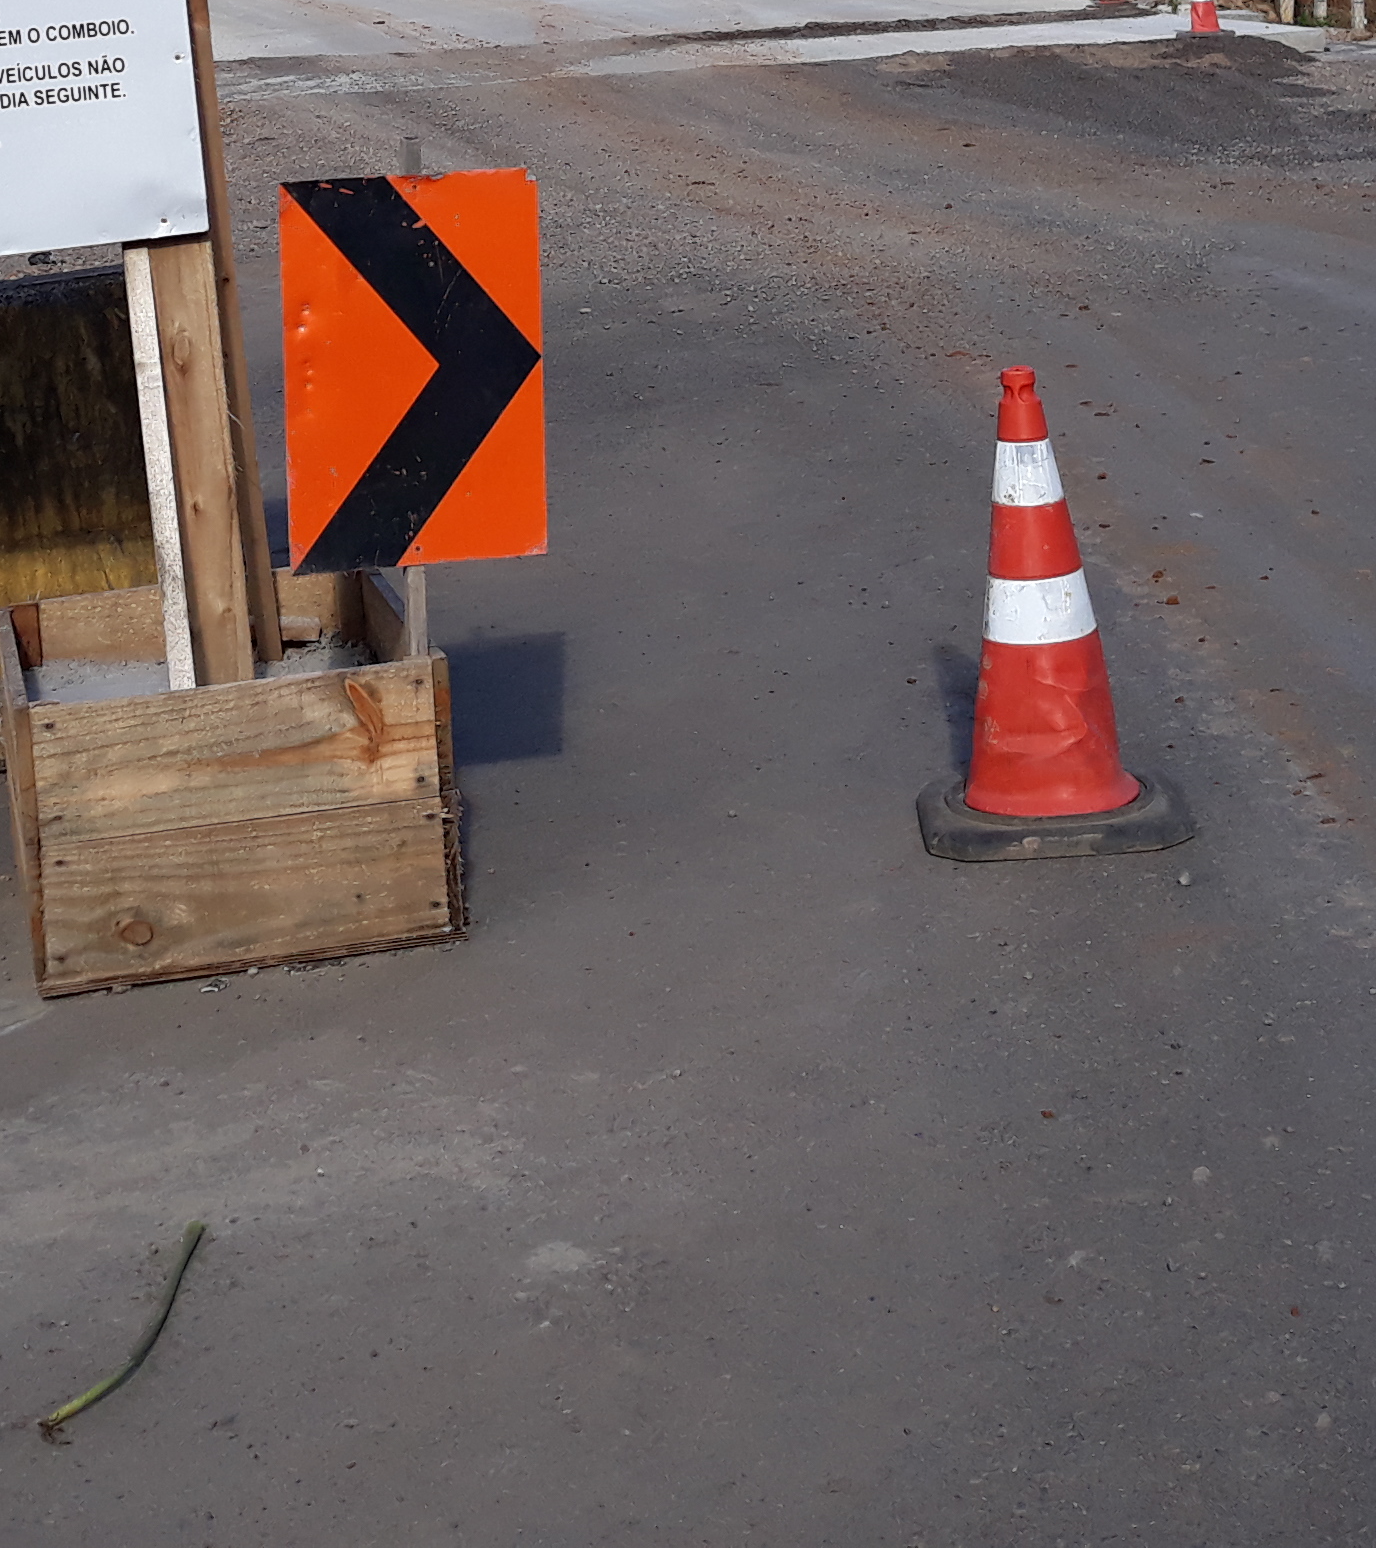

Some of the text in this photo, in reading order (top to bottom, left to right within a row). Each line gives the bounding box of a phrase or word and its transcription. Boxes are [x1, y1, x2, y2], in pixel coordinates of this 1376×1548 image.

[26, 26, 42, 45] O
[44, 18, 135, 43] COMBOIO.
[86, 51, 126, 76] NÃO
[32, 81, 127, 107] SEGUINTE.
